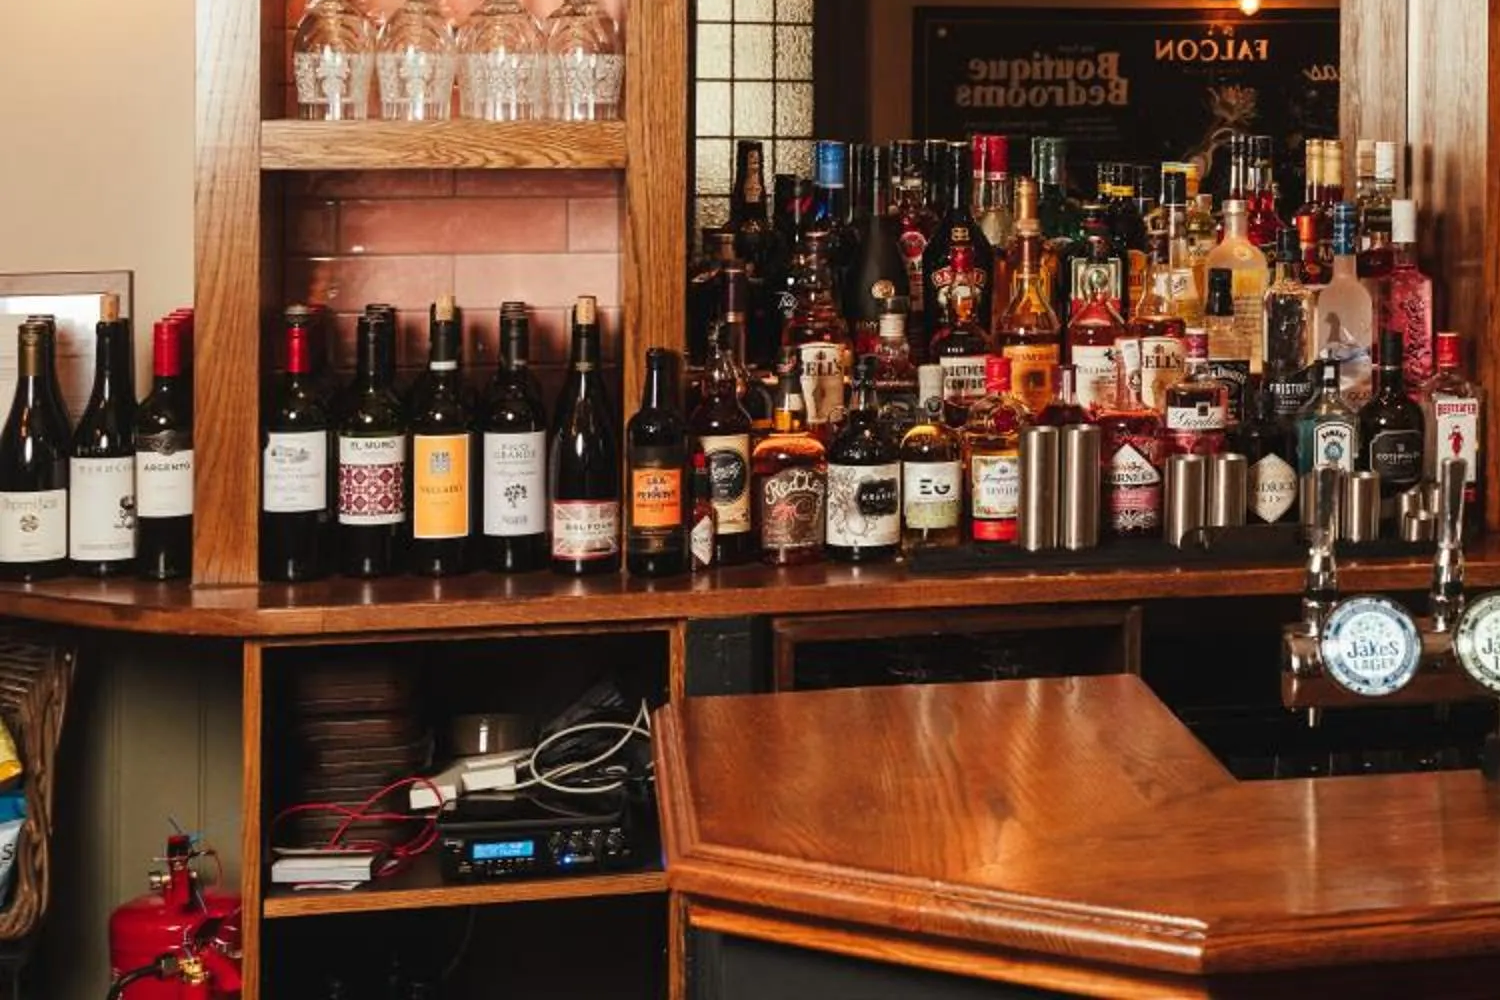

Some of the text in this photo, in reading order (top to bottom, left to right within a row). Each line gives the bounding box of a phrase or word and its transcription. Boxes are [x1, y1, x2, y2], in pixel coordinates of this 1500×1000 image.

[804, 357, 844, 377] ELL'S
[1144, 351, 1182, 369] ELL'S
[945, 364, 985, 377] SOUTHER
[945, 378, 985, 390] COMFOR
